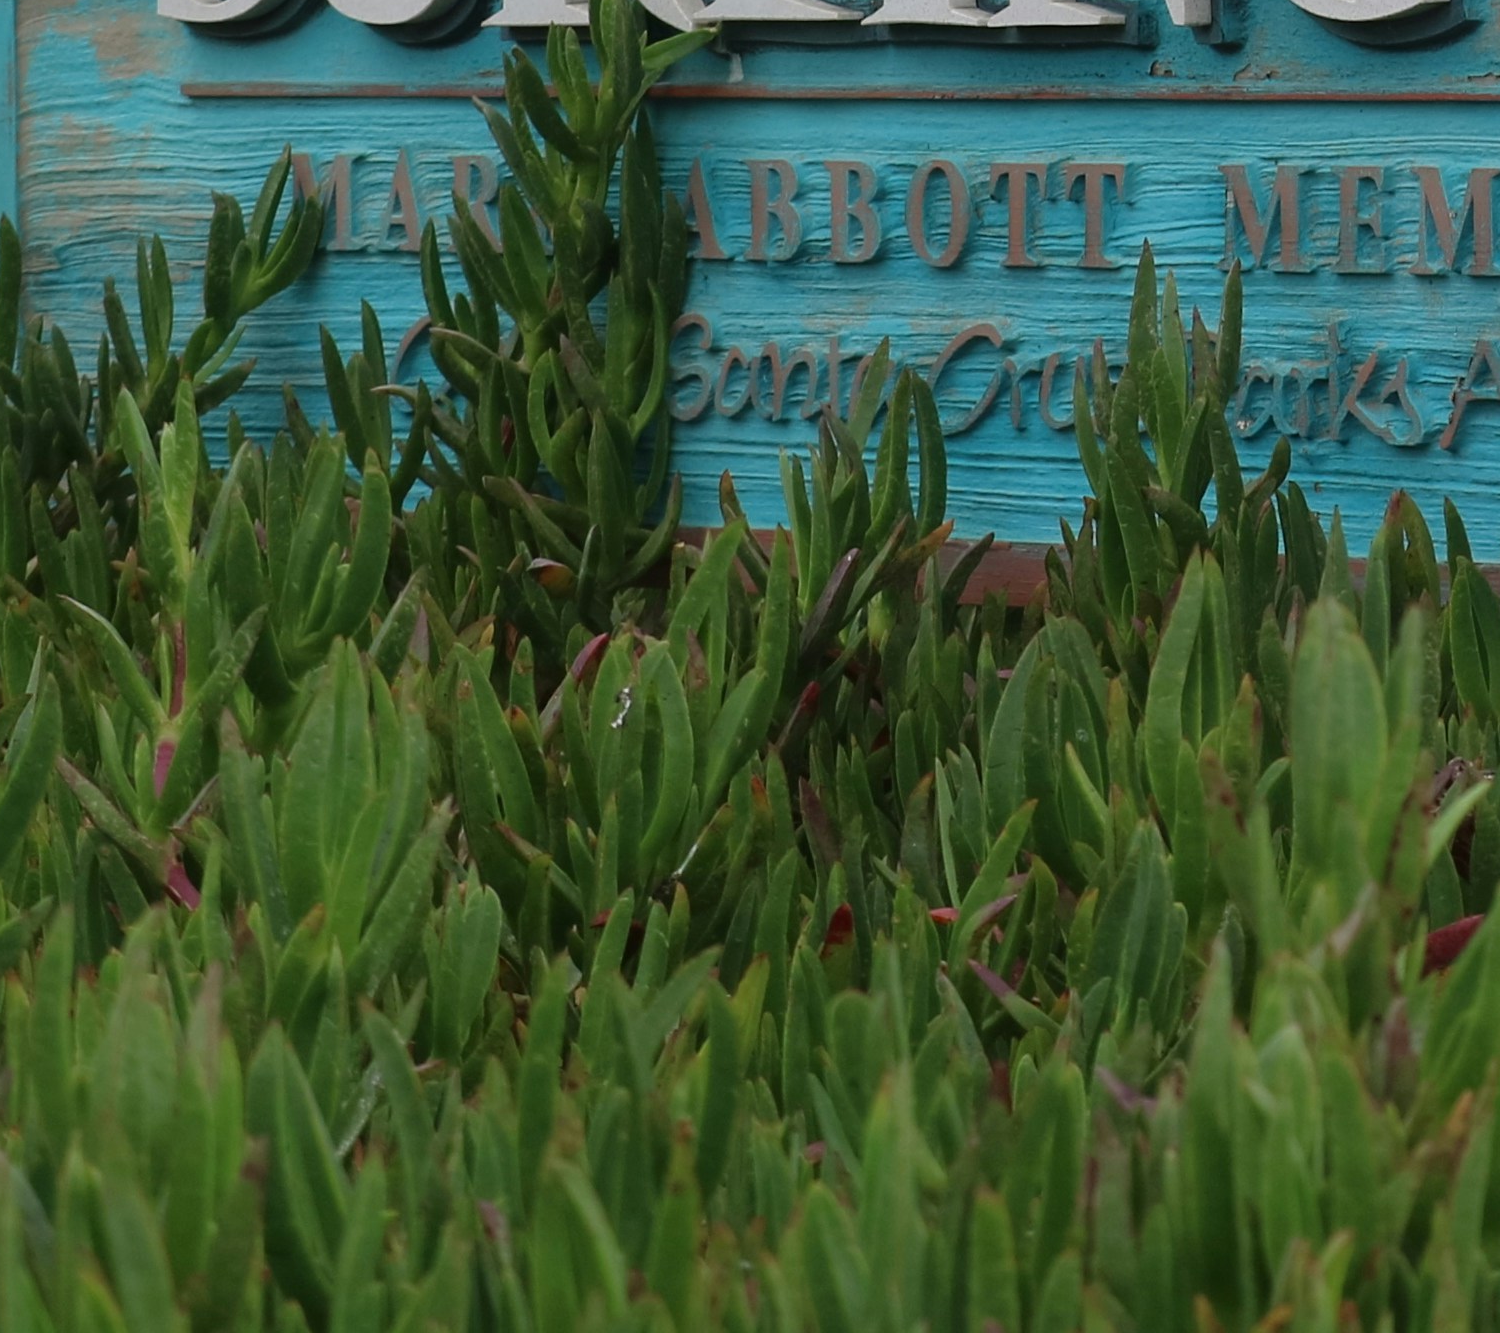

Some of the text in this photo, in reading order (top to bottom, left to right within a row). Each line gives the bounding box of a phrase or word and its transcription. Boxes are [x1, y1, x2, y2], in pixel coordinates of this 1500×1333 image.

[290, 147, 555, 255] MAR
[684, 157, 1126, 270] ABBOTT
[925, 321, 1150, 435] Cru
[1182, 323, 1424, 447] arks
